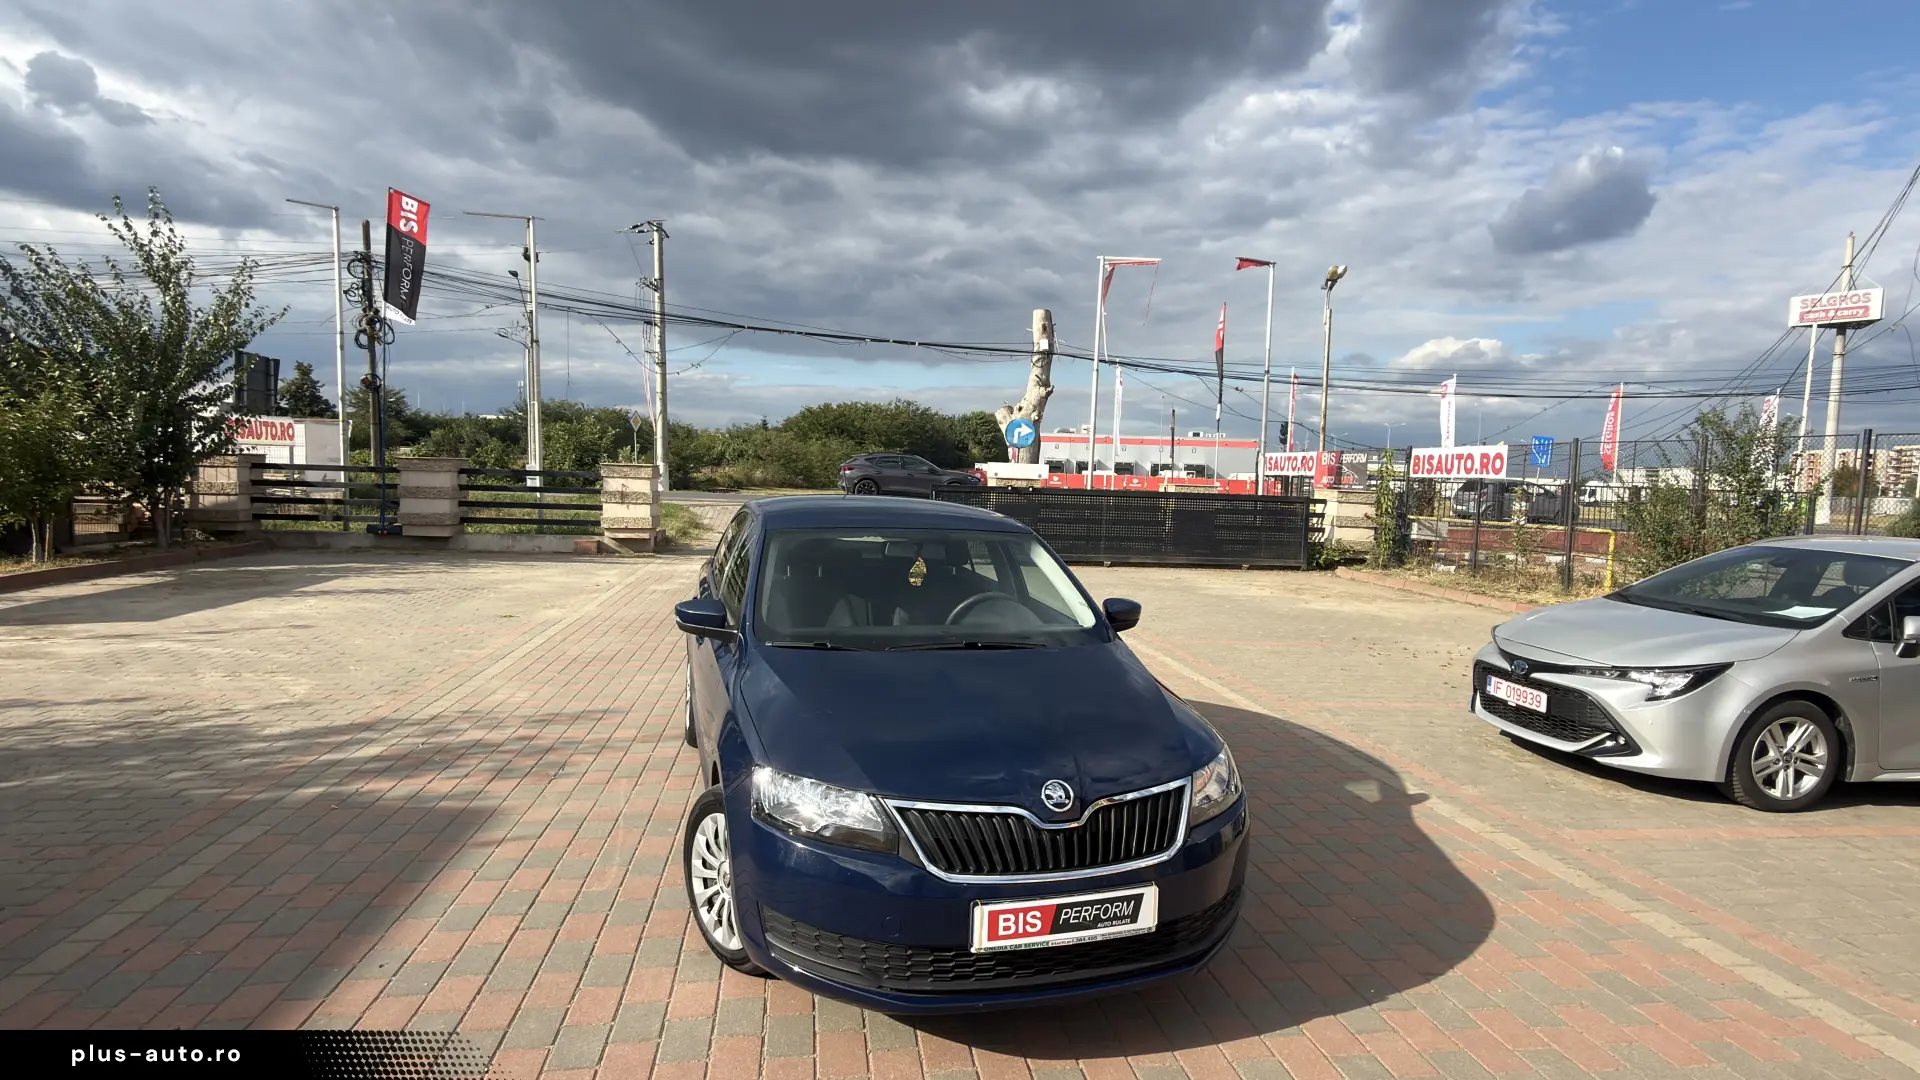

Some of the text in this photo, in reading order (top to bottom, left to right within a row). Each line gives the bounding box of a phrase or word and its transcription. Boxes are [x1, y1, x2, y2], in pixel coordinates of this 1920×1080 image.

[400, 196, 418, 299] BIS PERFORM
[1800, 292, 1872, 309] SELGROS
[1804, 308, 1865, 319] cash & carry
[1265, 455, 1315, 472] ISAUTO.RO
[1321, 452, 1336, 466] BIS
[1412, 452, 1504, 475] BISAUTO.RO
[1493, 680, 1542, 708] IF 019939
[998, 900, 1135, 936] BIS PERFORM
[1112, 918, 1131, 926] RULATE
[1024, 941, 1050, 949] SERVICE
